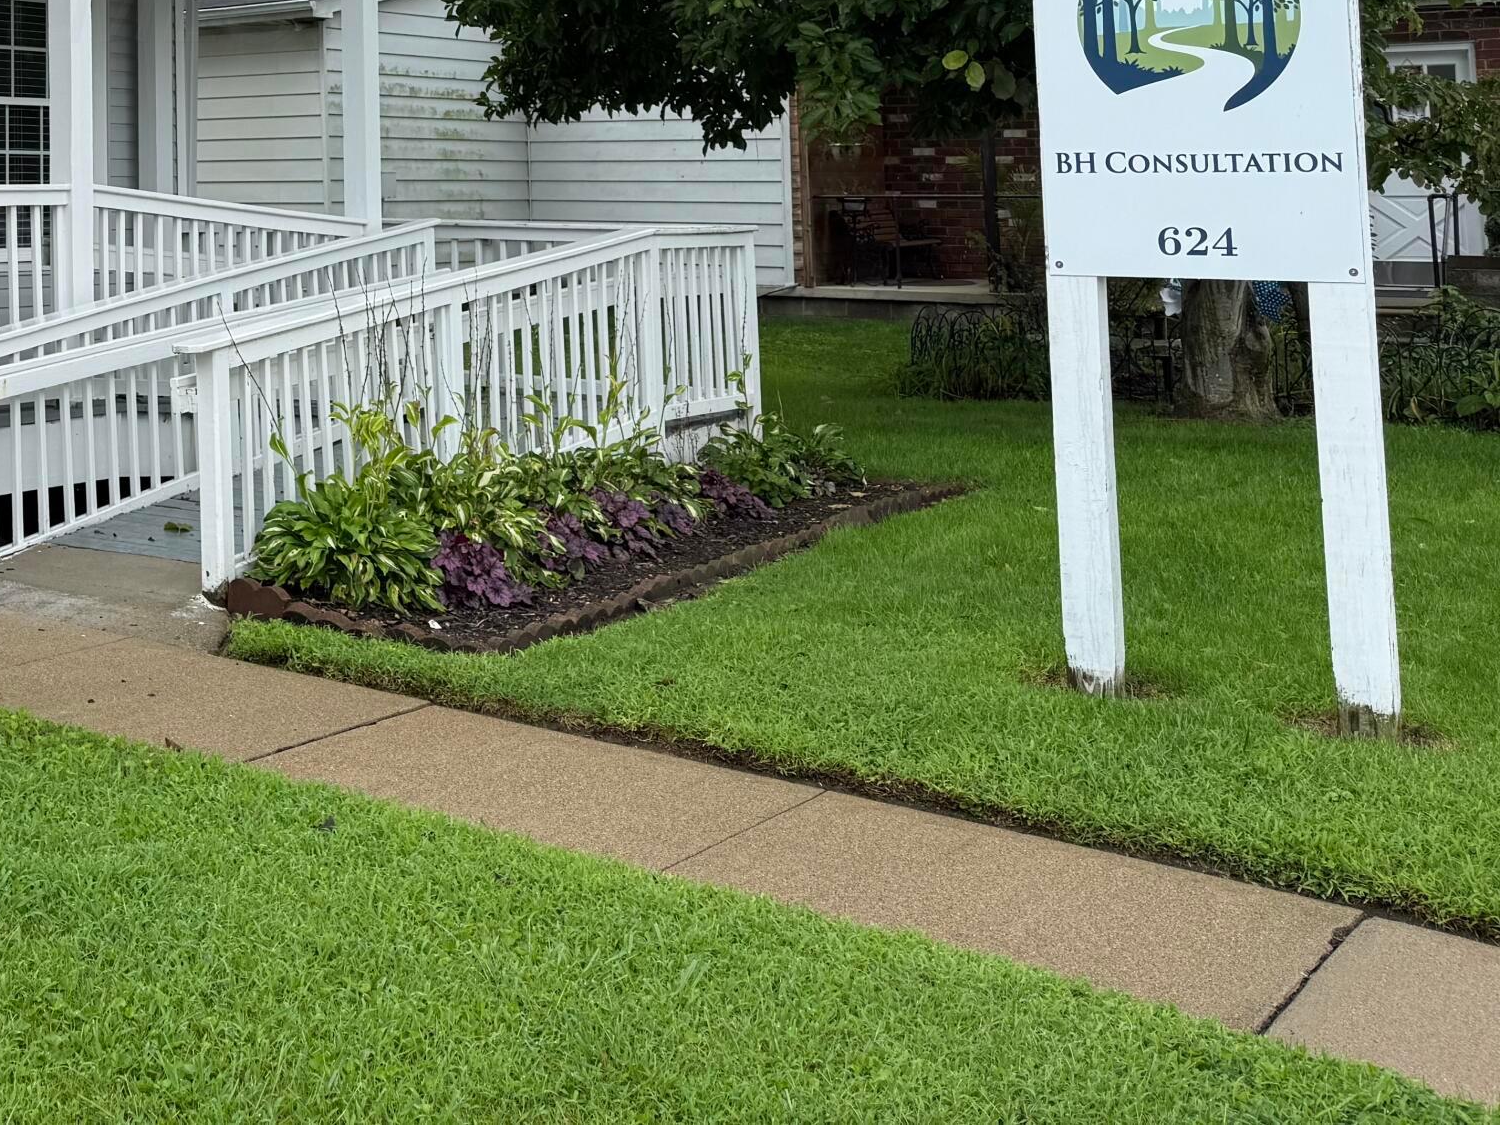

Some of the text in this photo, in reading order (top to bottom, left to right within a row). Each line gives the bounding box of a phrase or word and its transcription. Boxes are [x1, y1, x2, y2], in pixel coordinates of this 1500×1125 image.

[1055, 151, 1344, 174] BH CONSULTATION
[1157, 227, 1238, 257] 624
